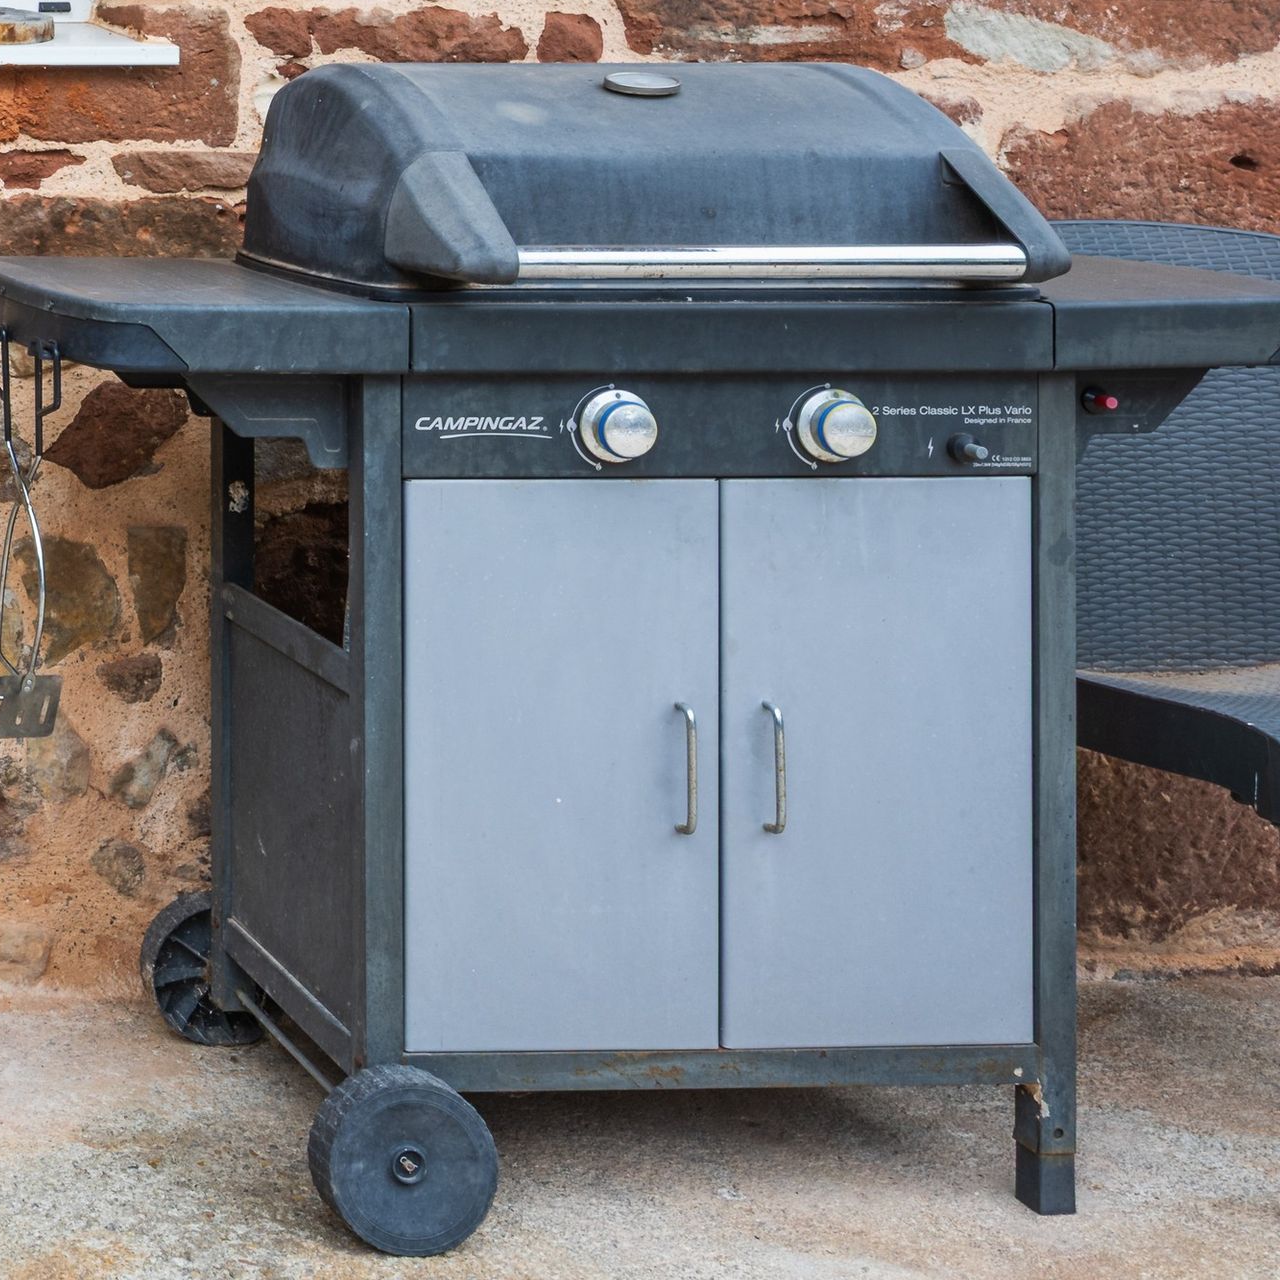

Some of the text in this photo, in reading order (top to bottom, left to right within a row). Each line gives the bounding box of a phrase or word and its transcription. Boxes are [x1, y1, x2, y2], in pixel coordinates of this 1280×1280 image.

[872, 406, 1032, 416] 2 Series Classic LX Plus Vario
[414, 416, 544, 431] CAMPINGAZ
[964, 417, 998, 425] Designed
